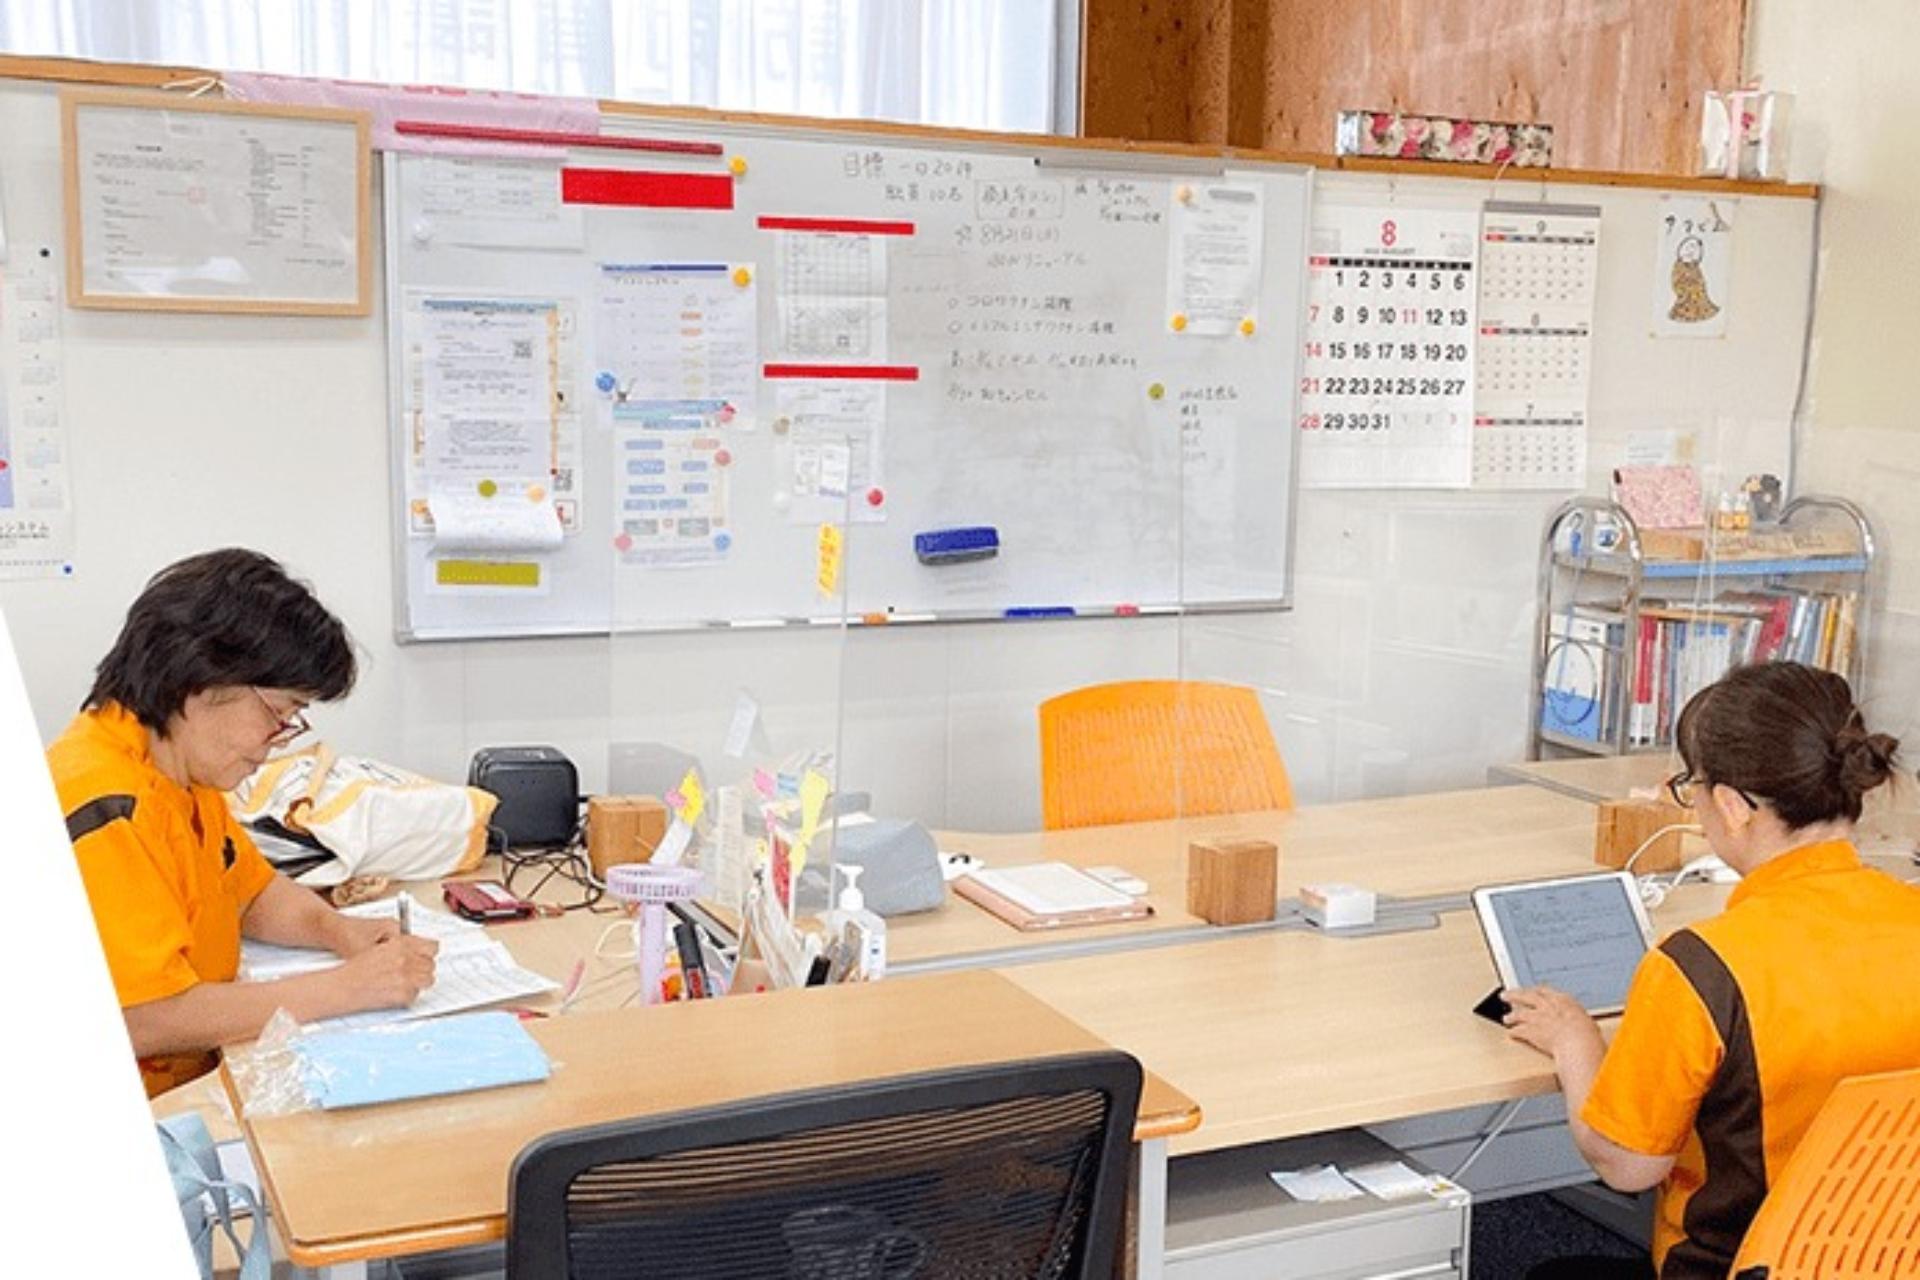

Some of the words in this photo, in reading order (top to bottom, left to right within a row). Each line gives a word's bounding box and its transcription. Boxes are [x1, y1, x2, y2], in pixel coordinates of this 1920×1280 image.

[1381, 219, 1397, 247] 8
[1336, 271, 1344, 287] 1
[1359, 270, 1370, 288] 2
[1382, 271, 1394, 289] 3
[1406, 272, 1417, 289] 4
[1430, 272, 1441, 291] 5
[1453, 272, 1465, 291] 6
[1309, 304, 1320, 322] 7
[1332, 305, 1345, 324] 8
[1357, 306, 1369, 324] 9
[1378, 307, 1396, 324] 10
[1402, 308, 1417, 324] 11
[1426, 308, 1444, 326] 12
[1449, 308, 1467, 327] 13
[1304, 342, 1322, 358] 14
[1329, 341, 1347, 360] 15
[1353, 342, 1371, 360] 16
[1377, 343, 1394, 359] 17
[1400, 343, 1418, 361] 18
[1423, 343, 1441, 362] 19
[1445, 343, 1466, 362] 20
[1301, 377, 1320, 395] 21
[1325, 377, 1346, 394] 22
[1348, 377, 1370, 395] 23
[1373, 377, 1393, 395] 24
[1396, 378, 1416, 396] 25
[1419, 378, 1441, 396] 26
[1443, 379, 1466, 396] 27
[1299, 413, 1321, 430] 28
[1323, 413, 1344, 430] 29
[1347, 413, 1369, 431] 30
[1371, 413, 1390, 431] 31
